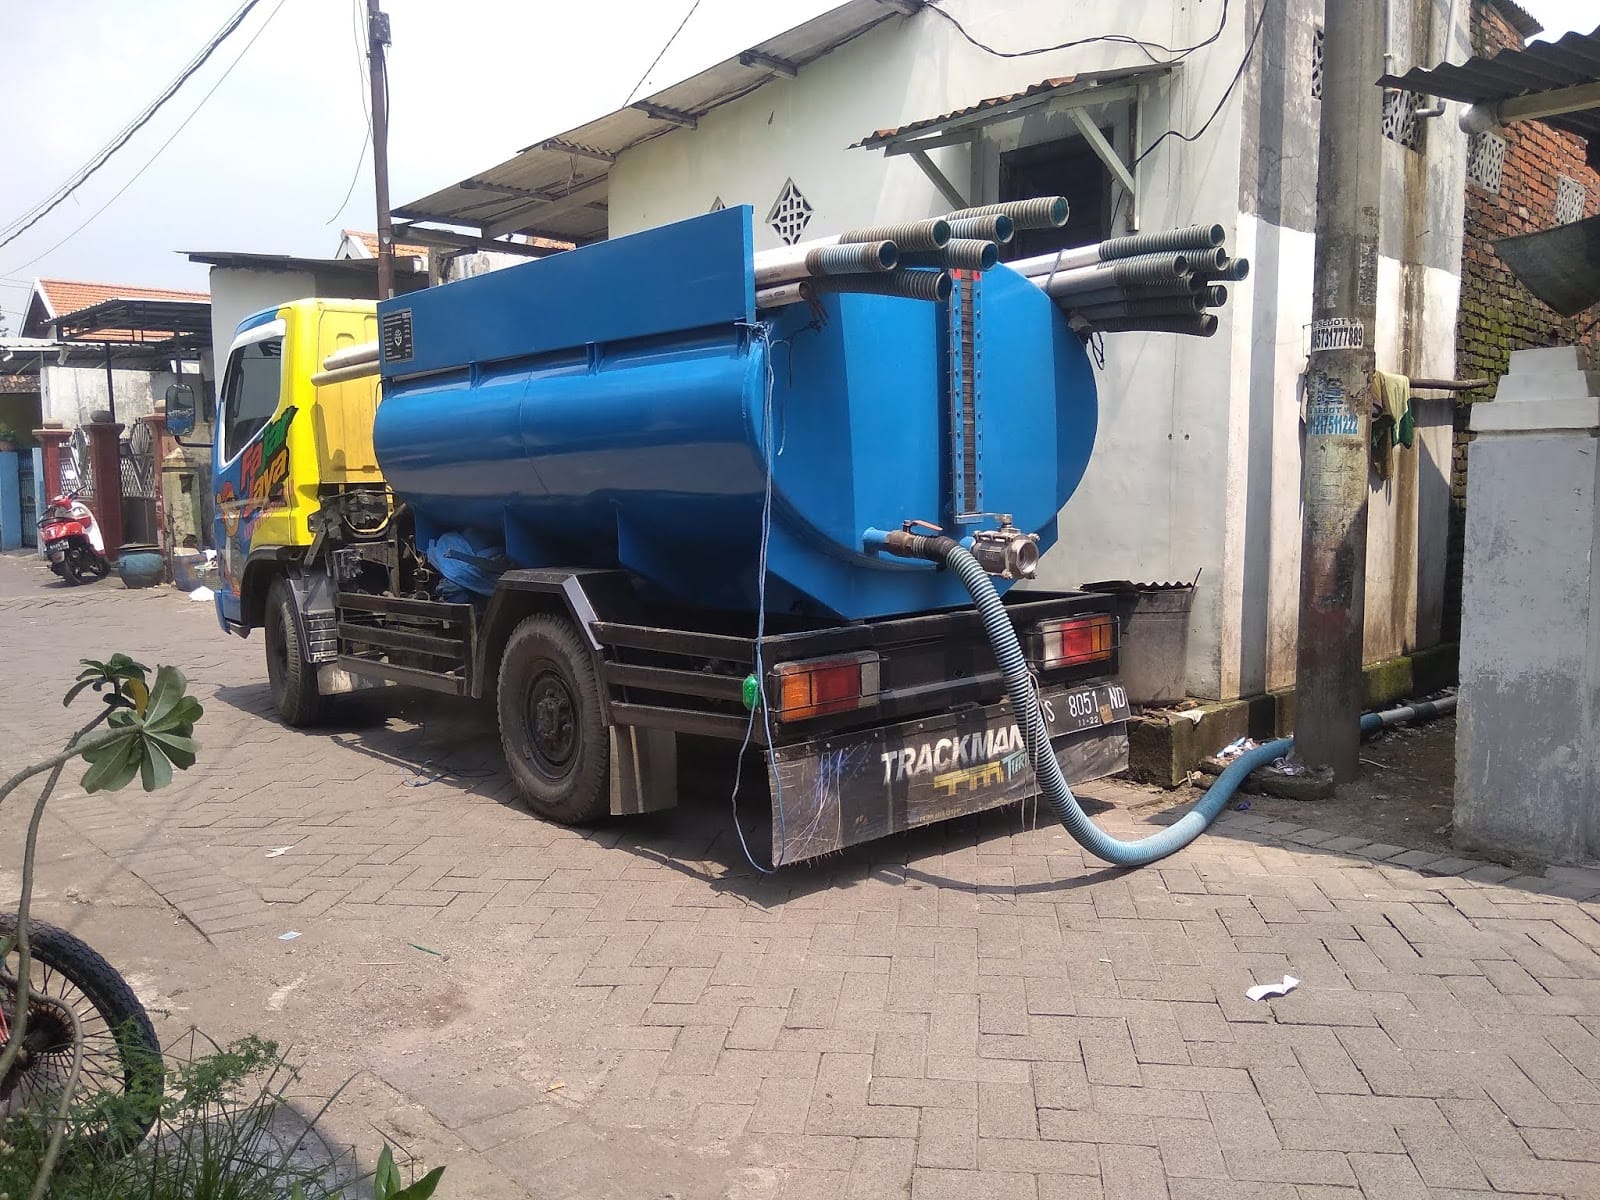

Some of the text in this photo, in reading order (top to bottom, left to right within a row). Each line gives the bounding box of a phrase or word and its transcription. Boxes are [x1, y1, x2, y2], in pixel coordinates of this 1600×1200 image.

[1044, 686, 1126, 722] S 8051 ND
